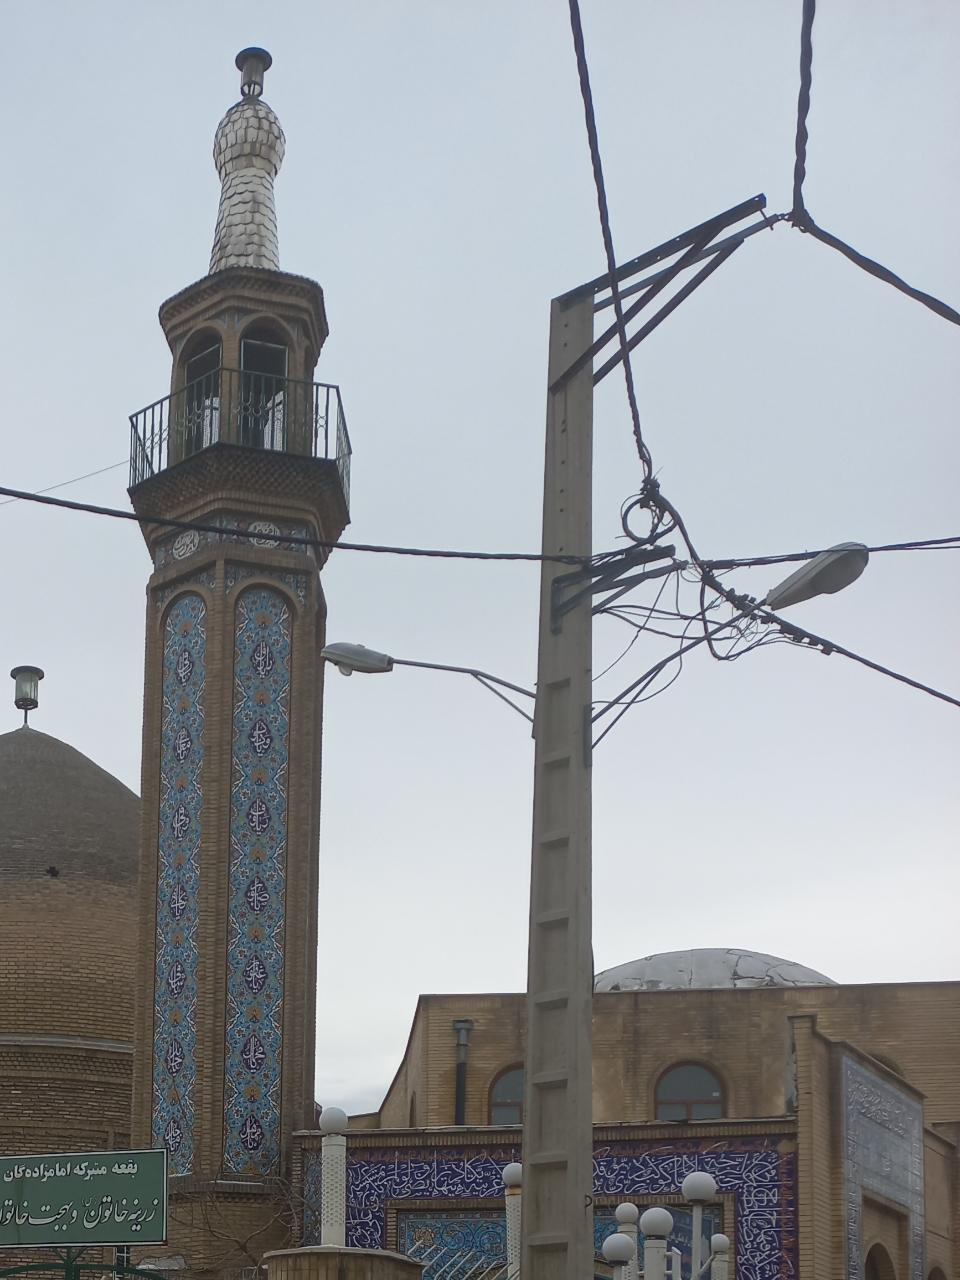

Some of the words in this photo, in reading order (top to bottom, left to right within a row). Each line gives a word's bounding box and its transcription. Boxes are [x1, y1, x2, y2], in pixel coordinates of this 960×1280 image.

[73, 1161, 107, 1181] متبرکه
[111, 1159, 138, 1179] بقعه
[28, 1201, 74, 1232] بهجت
[69, 1209, 78, 1225] و
[83, 1195, 129, 1229] خاتون
[127, 1198, 159, 1232] زرینه
